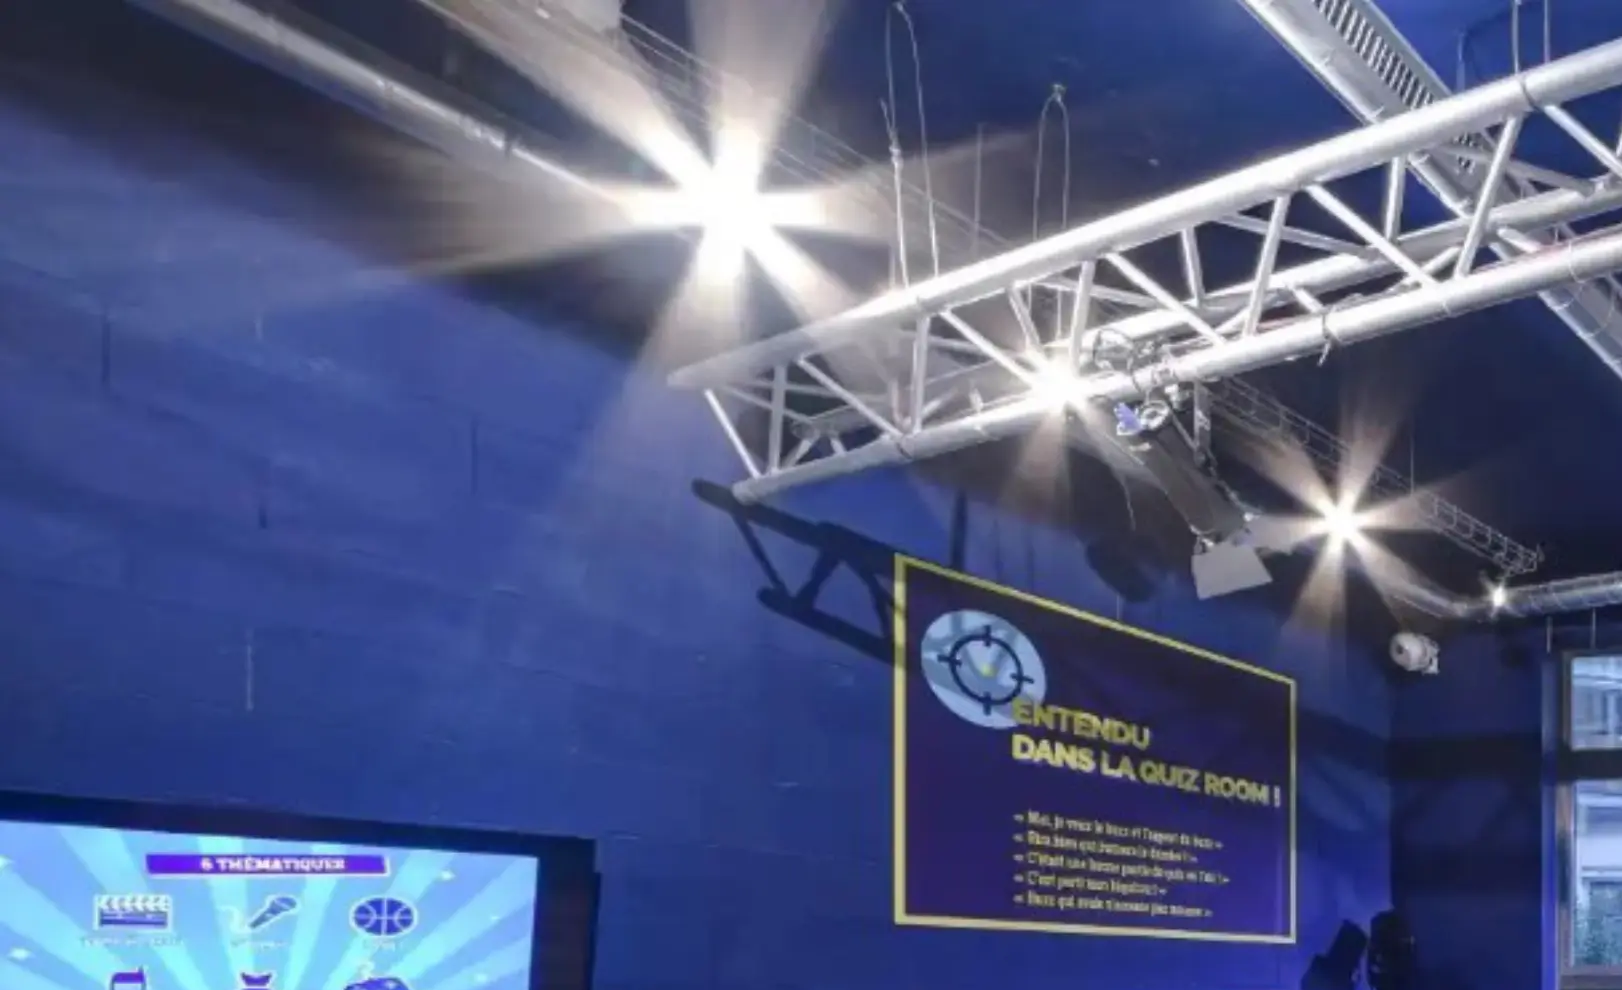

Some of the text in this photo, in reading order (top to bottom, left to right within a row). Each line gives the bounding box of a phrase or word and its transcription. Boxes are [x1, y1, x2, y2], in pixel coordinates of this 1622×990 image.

[1011, 696, 1151, 749] ENTENDU
[1011, 733, 1096, 774] DANS
[1100, 751, 1136, 782] LA
[1139, 760, 1200, 792] QUIZ
[1204, 771, 1270, 806] ROOM
